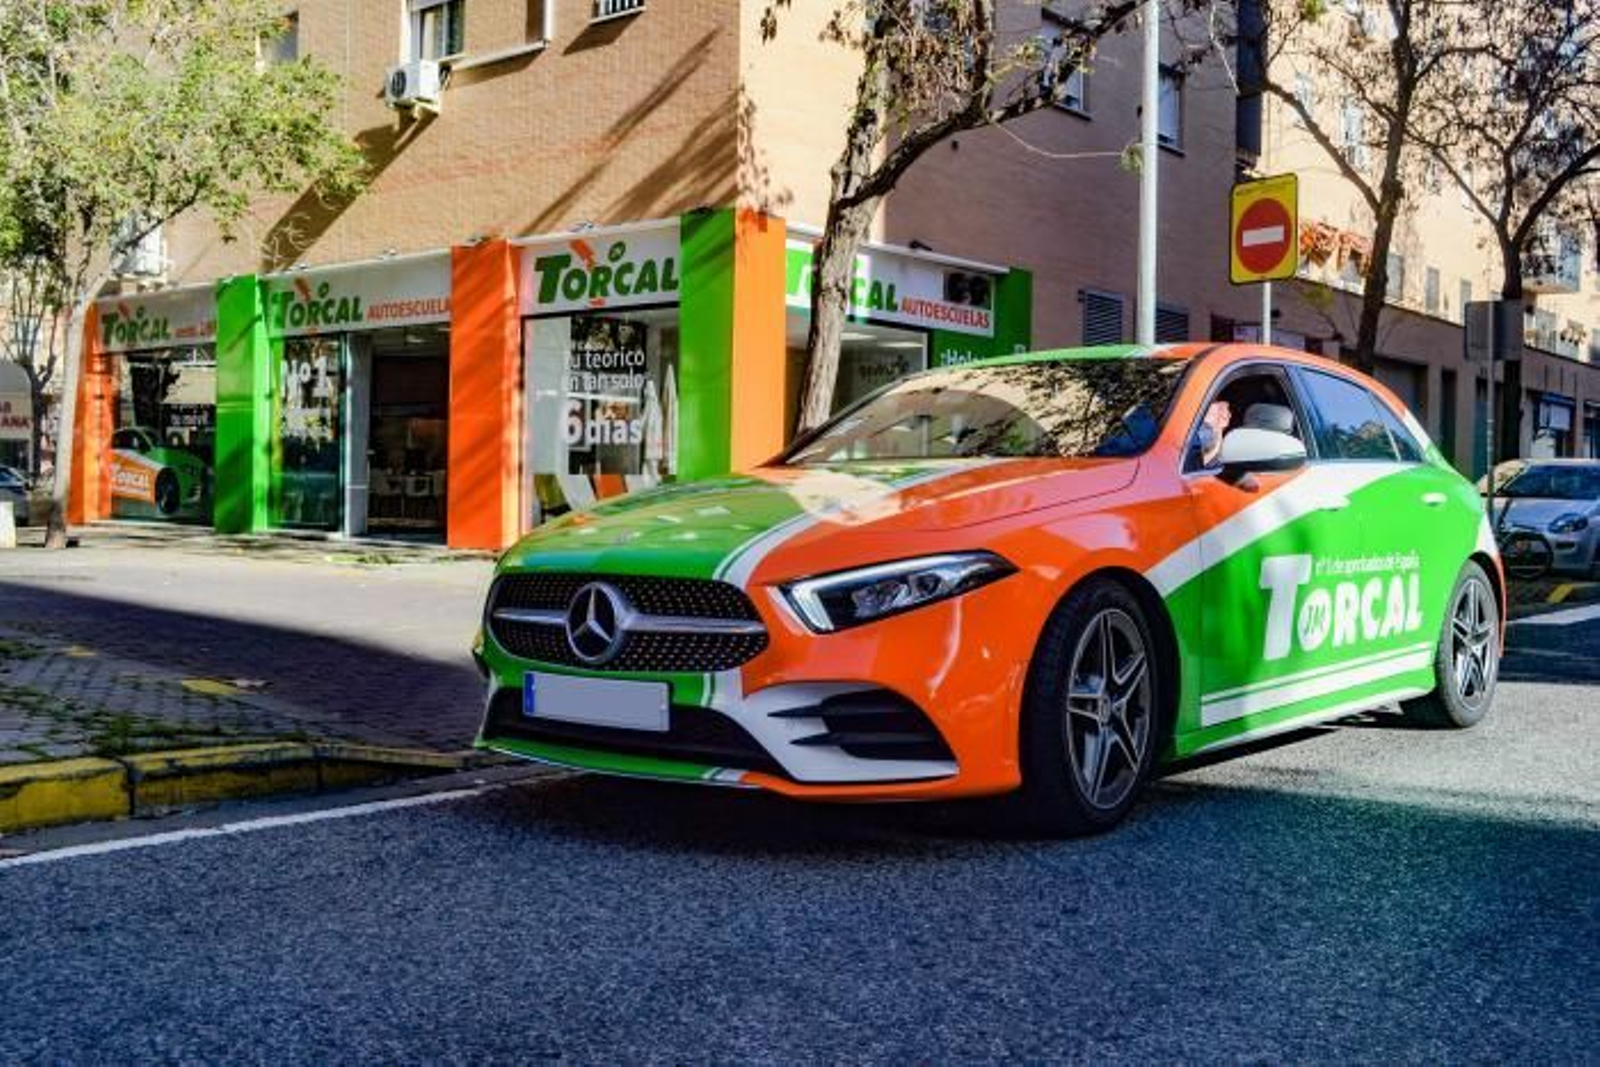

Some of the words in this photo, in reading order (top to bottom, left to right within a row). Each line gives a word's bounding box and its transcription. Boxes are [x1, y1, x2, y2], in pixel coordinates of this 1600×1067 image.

[534, 252, 679, 304] TORCAL
[101, 312, 171, 346] TORCAL
[271, 291, 363, 329] TORCAL
[901, 296, 990, 329] AUTOESCUELAS
[1259, 553, 1422, 661] TORCAL
